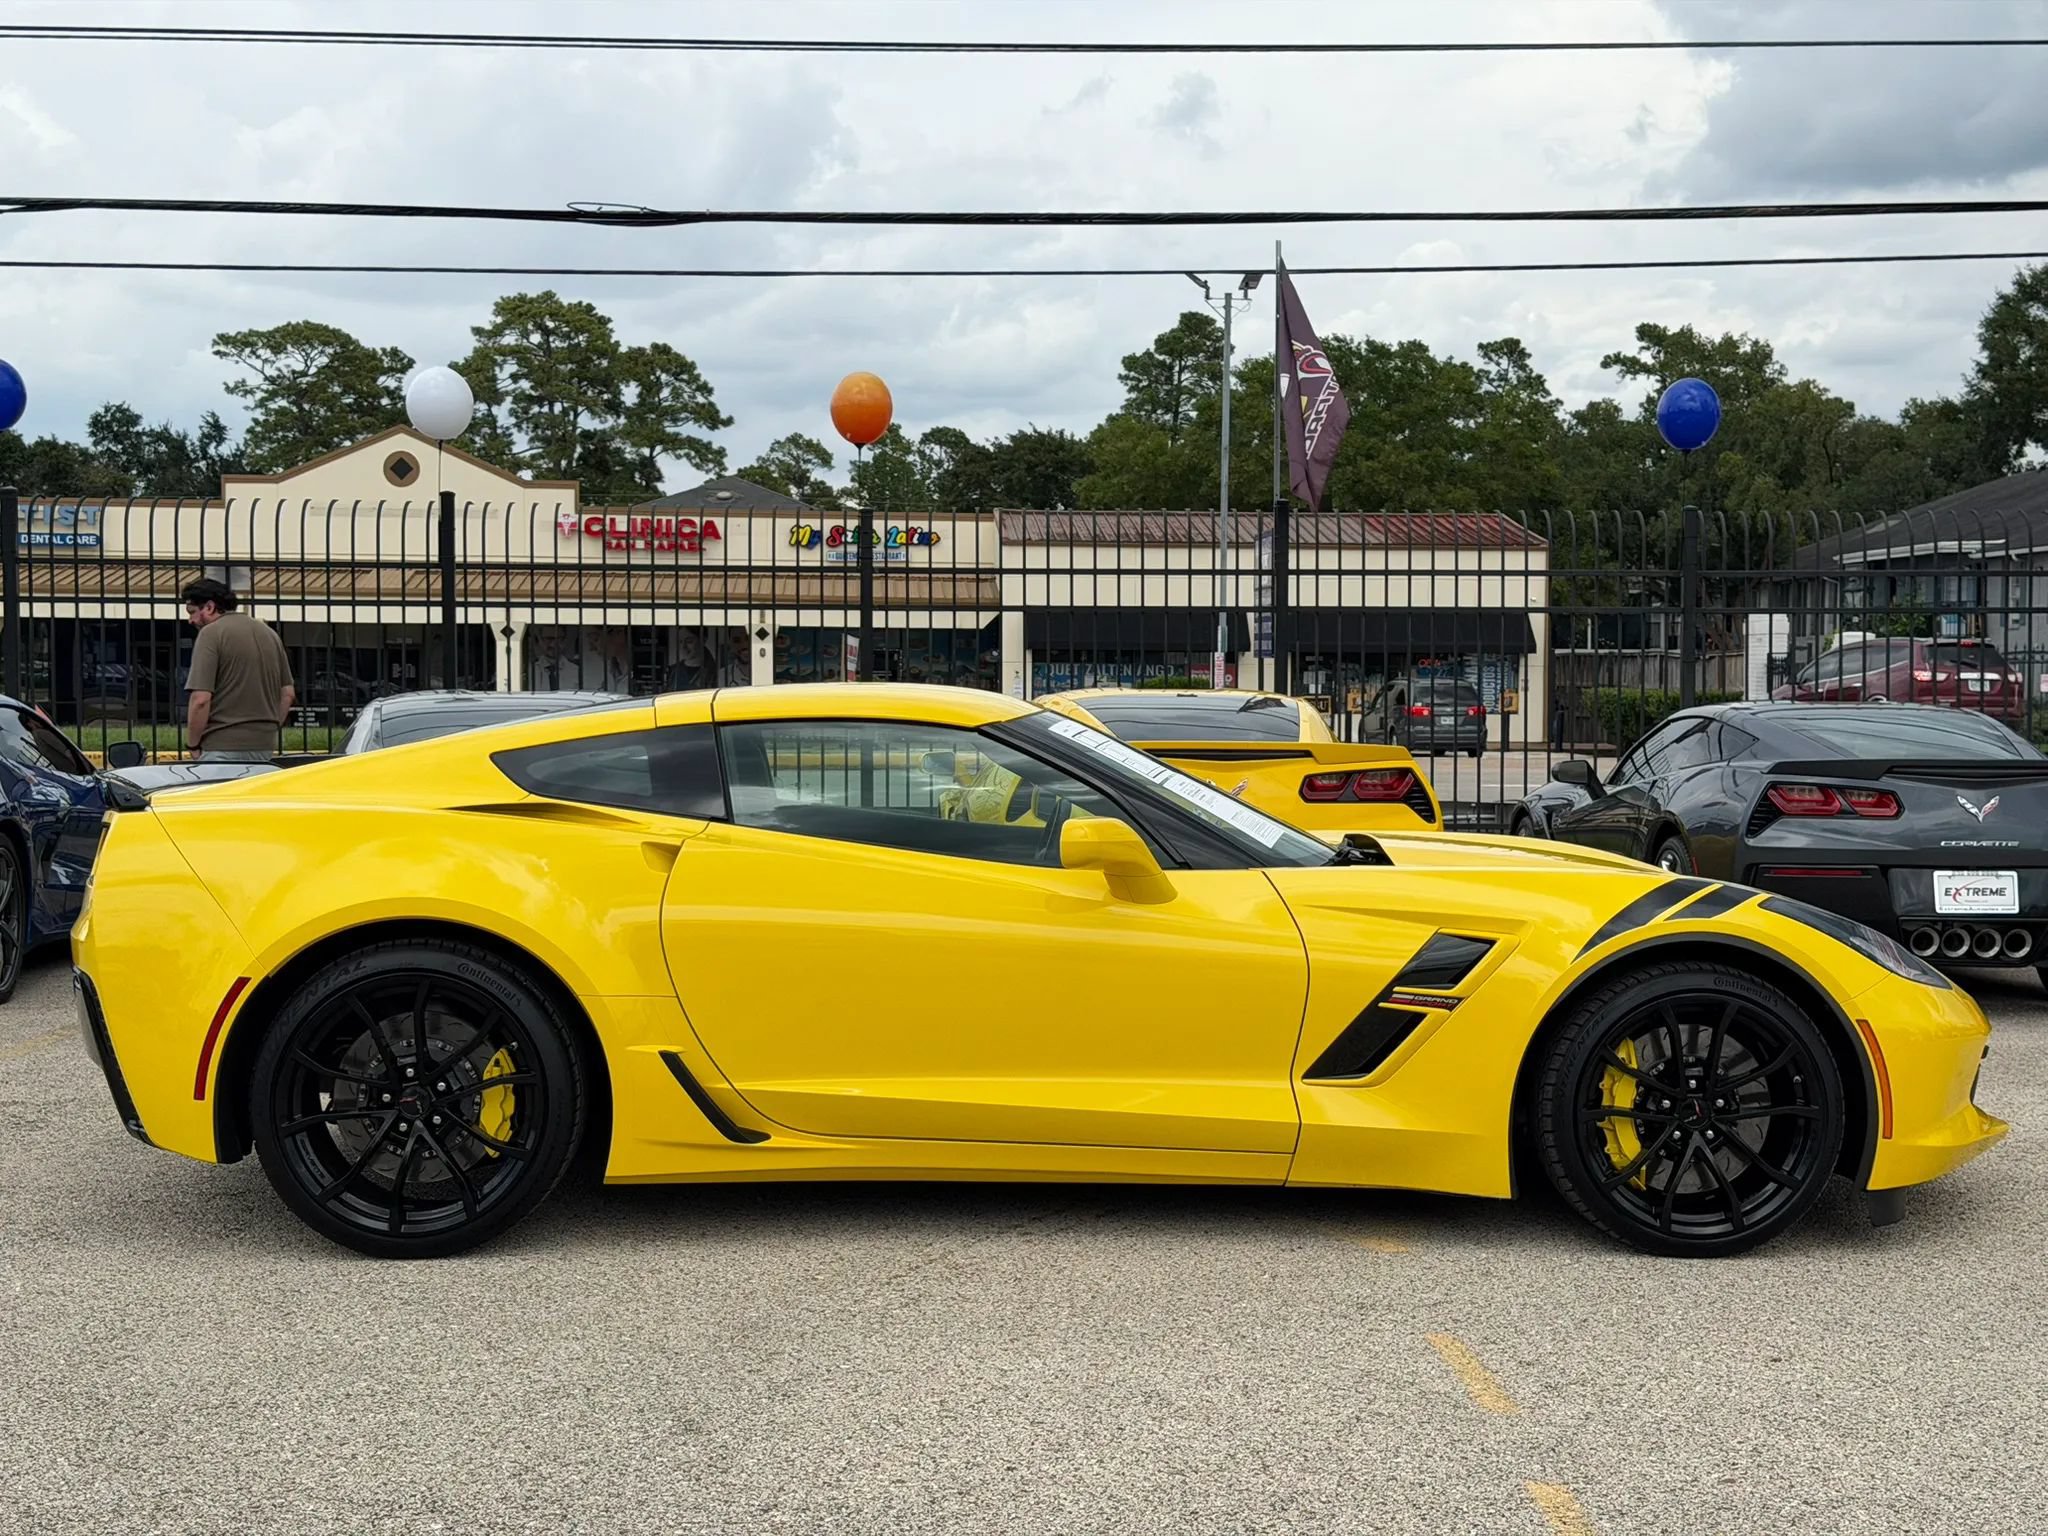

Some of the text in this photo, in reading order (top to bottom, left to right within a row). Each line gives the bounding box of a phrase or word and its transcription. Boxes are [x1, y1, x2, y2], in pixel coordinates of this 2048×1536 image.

[584, 517, 722, 540] CLINICA
[20, 534, 97, 545] DENTAL CARE
[1944, 887, 2008, 897] EXTREME
[1415, 995, 1458, 1004] GRAND
